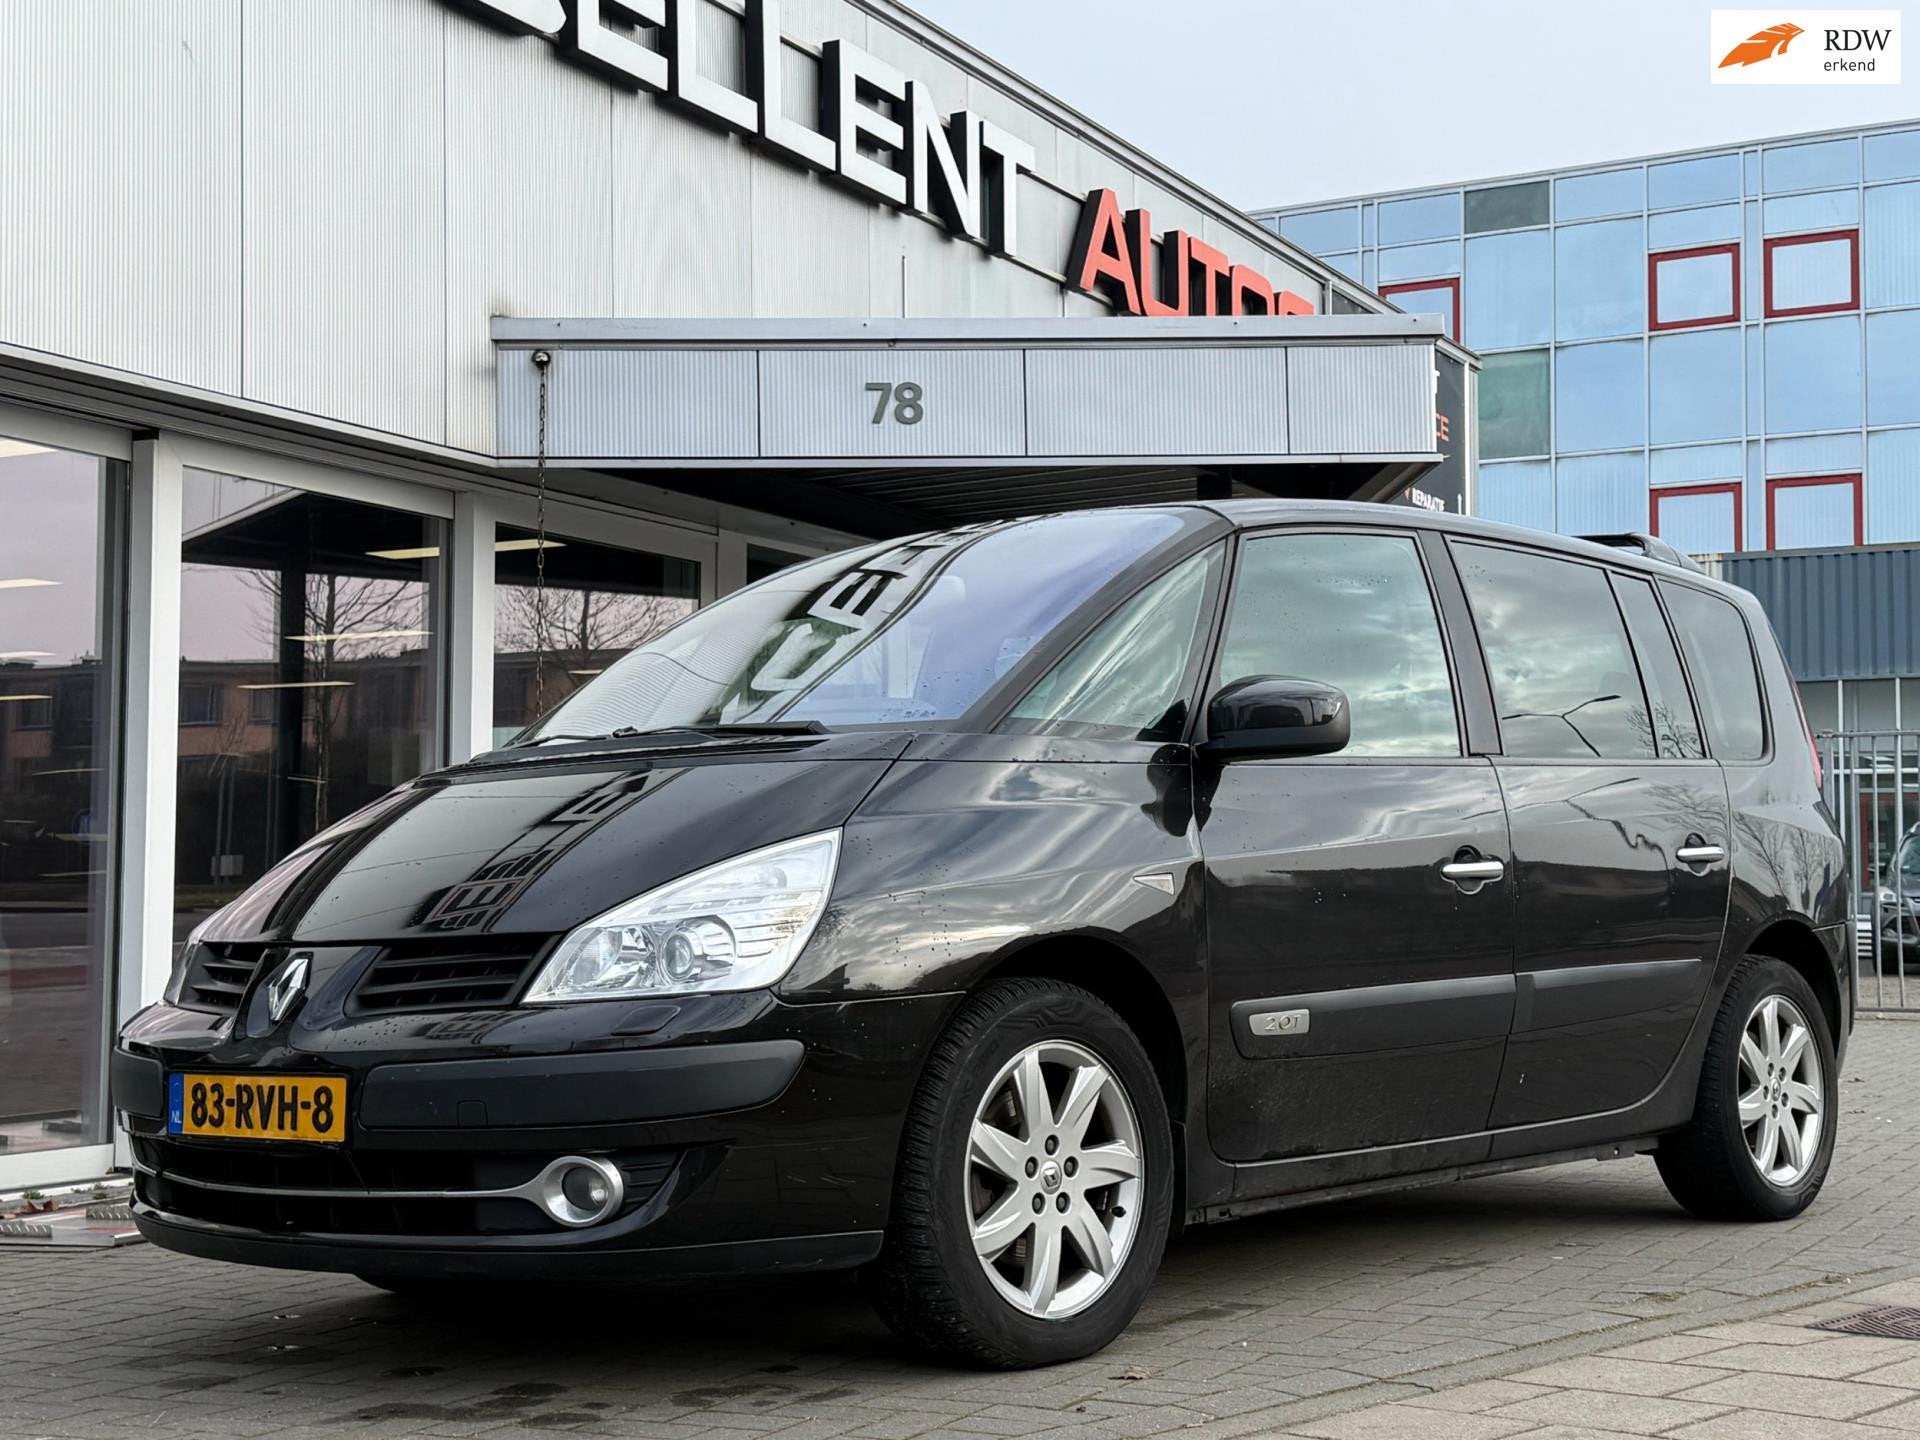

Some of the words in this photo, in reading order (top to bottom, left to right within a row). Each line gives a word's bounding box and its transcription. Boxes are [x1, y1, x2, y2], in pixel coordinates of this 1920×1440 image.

[476, 0, 1035, 257] LLENT
[1078, 187, 1314, 317] AUT
[865, 382, 924, 425] 78
[171, 1112, 182, 1124] NL
[191, 1083, 334, 1133] 83-RVH-8
